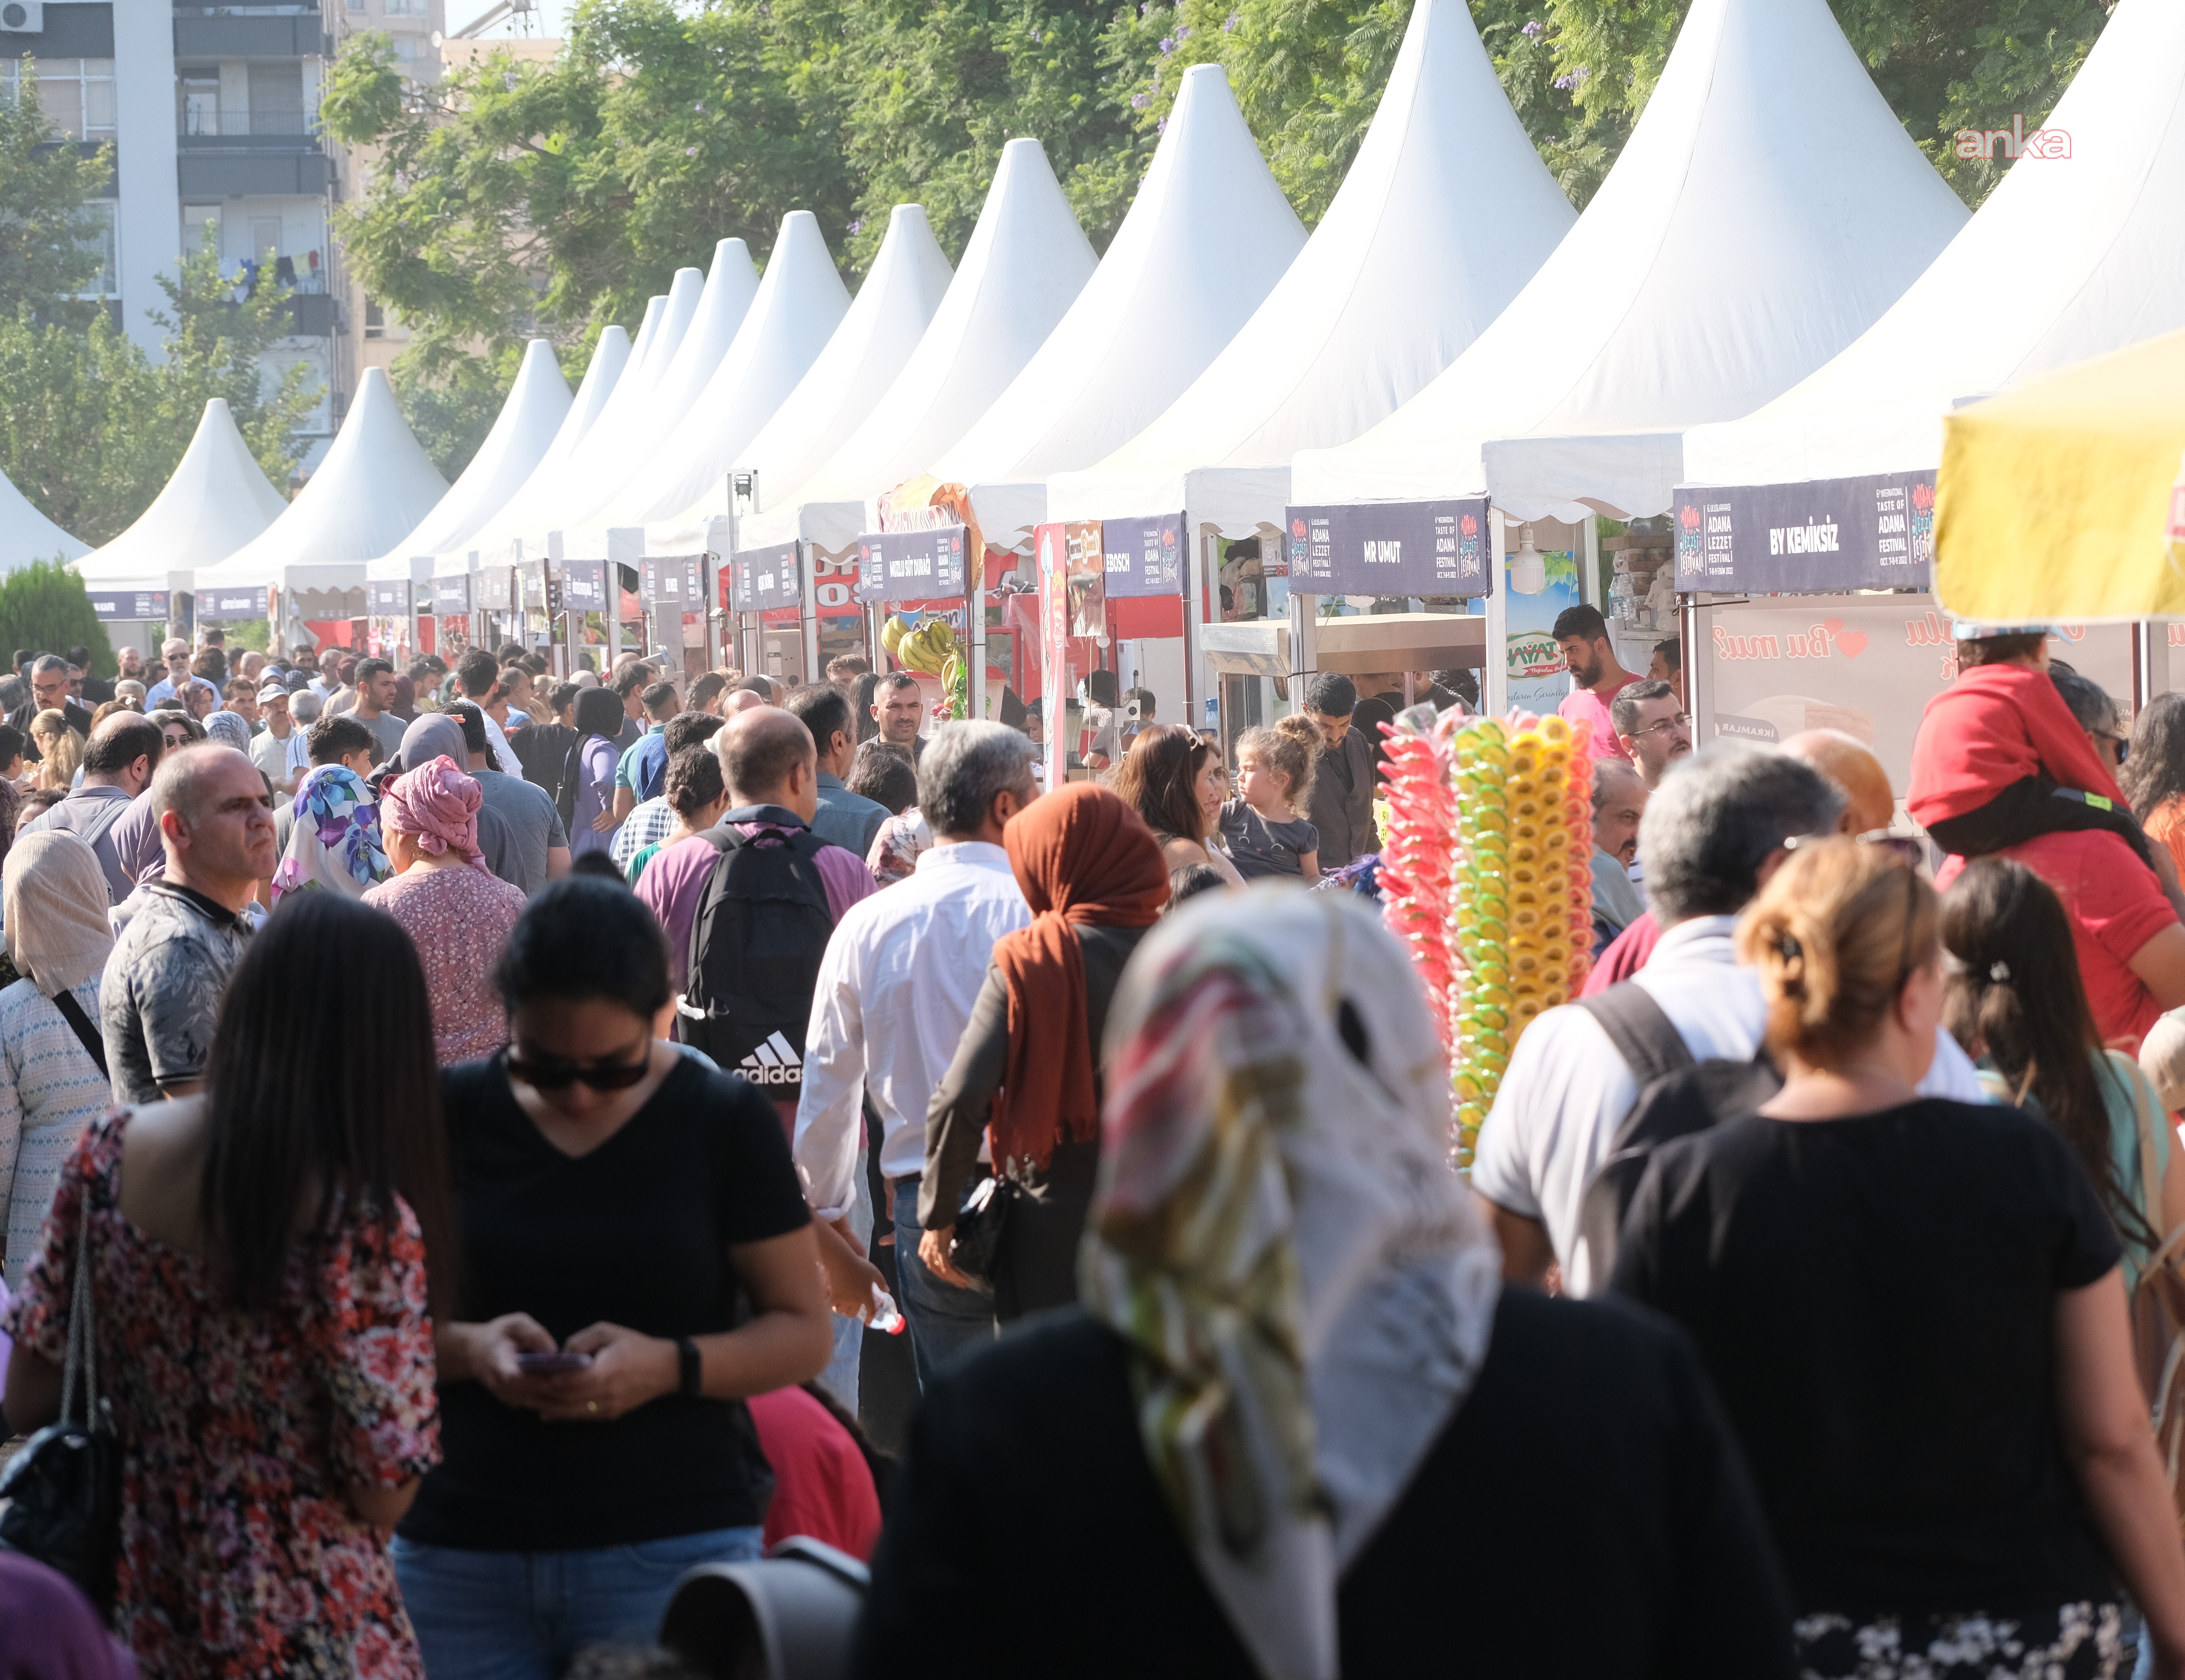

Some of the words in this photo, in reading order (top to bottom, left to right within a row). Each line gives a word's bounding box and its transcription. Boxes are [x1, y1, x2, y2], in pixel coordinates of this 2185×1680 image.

[1877, 500, 1895, 512] TASTE
[1897, 500, 1904, 509] OF
[1681, 505, 1700, 529] ADANA
[1879, 514, 1906, 533] ADANA
[1292, 518, 1306, 537] ADANA
[1436, 526, 1448, 535] TASTE
[1449, 526, 1455, 534] OF
[1461, 514, 1477, 535] ADANA
[1708, 516, 1732, 533] ADANA
[1312, 529, 1330, 542] ADANA
[1682, 529, 1699, 552] LEZZET
[1769, 528, 1785, 555] BY
[1786, 514, 1839, 554] KEMİKSİZ
[1436, 538, 1455, 552] ADANA
[1708, 536, 1732, 550] LEZZET
[1879, 538, 1906, 552] FESTIVAL
[1145, 549, 1159, 562] ADANA
[1312, 545, 1330, 556] LEZZET
[1364, 541, 1377, 563] MR
[1378, 541, 1401, 563] UMUT
[1709, 550, 1733, 563] FESTİVALİ
[890, 560, 905, 578] MUZLU
[905, 554, 913, 577] SÜT
[913, 553, 931, 576] DURAĞI
[938, 554, 949, 566] ADANA
[1313, 557, 1331, 568] FESTİVALİ
[1436, 556, 1456, 568] FESTIVAL
[1880, 558, 1888, 566] OCT.
[1889, 556, 1898, 565] 7-8-9
[1898, 556, 1907, 564] 2022
[872, 564, 883, 573] LEZZET
[1145, 565, 1159, 575] FESTIVAL
[1717, 566, 1725, 575] EKİM
[1507, 691, 1532, 701] osların
[732, 1064, 804, 1084] adida
